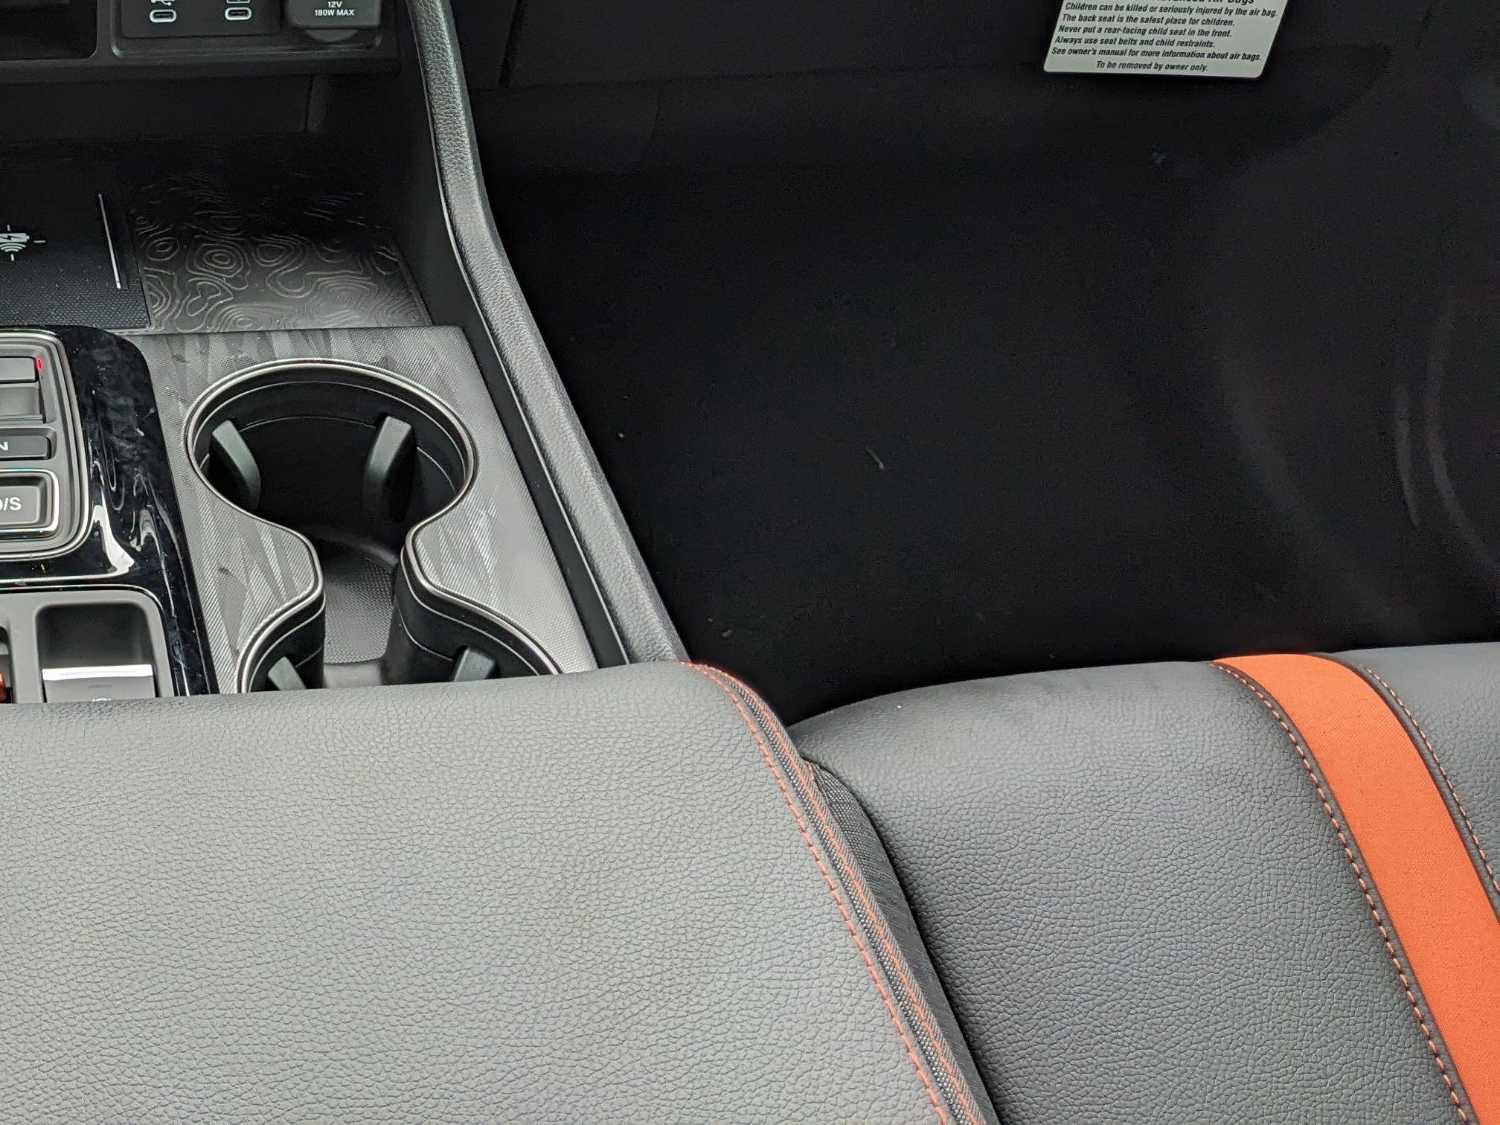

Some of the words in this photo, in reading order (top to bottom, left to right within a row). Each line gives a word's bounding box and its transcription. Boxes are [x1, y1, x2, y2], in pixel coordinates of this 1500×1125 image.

[1065, 2, 1097, 10] Children
[1126, 4, 1147, 12] killed
[1159, 6, 1194, 14] seriously
[1195, 6, 1222, 15] injured
[1224, 7, 1233, 15] by
[1249, 8, 1260, 16] air
[1261, 9, 1277, 18] bag.
[1078, 14, 1096, 22] back
[1098, 15, 1115, 23] seat
[1126, 15, 1138, 23] the
[1140, 16, 1164, 24] safest
[1165, 17, 1186, 25] place
[1188, 17, 1199, 25] for
[1201, 18, 1235, 26] children.
[1082, 26, 1096, 34] put
[1104, 27, 1147, 35] rear-facing
[1148, 27, 1167, 35] child
[1211, 29, 1232, 37] front.
[1055, 36, 1082, 45] Always
[1118, 37, 1137, 45] belts
[1176, 39, 1215, 48] restraints.
[1107, 61, 1116, 69] be
[1118, 61, 1152, 69] removed
[1153, 62, 1163, 71] by
[1190, 64, 1208, 72] only.
